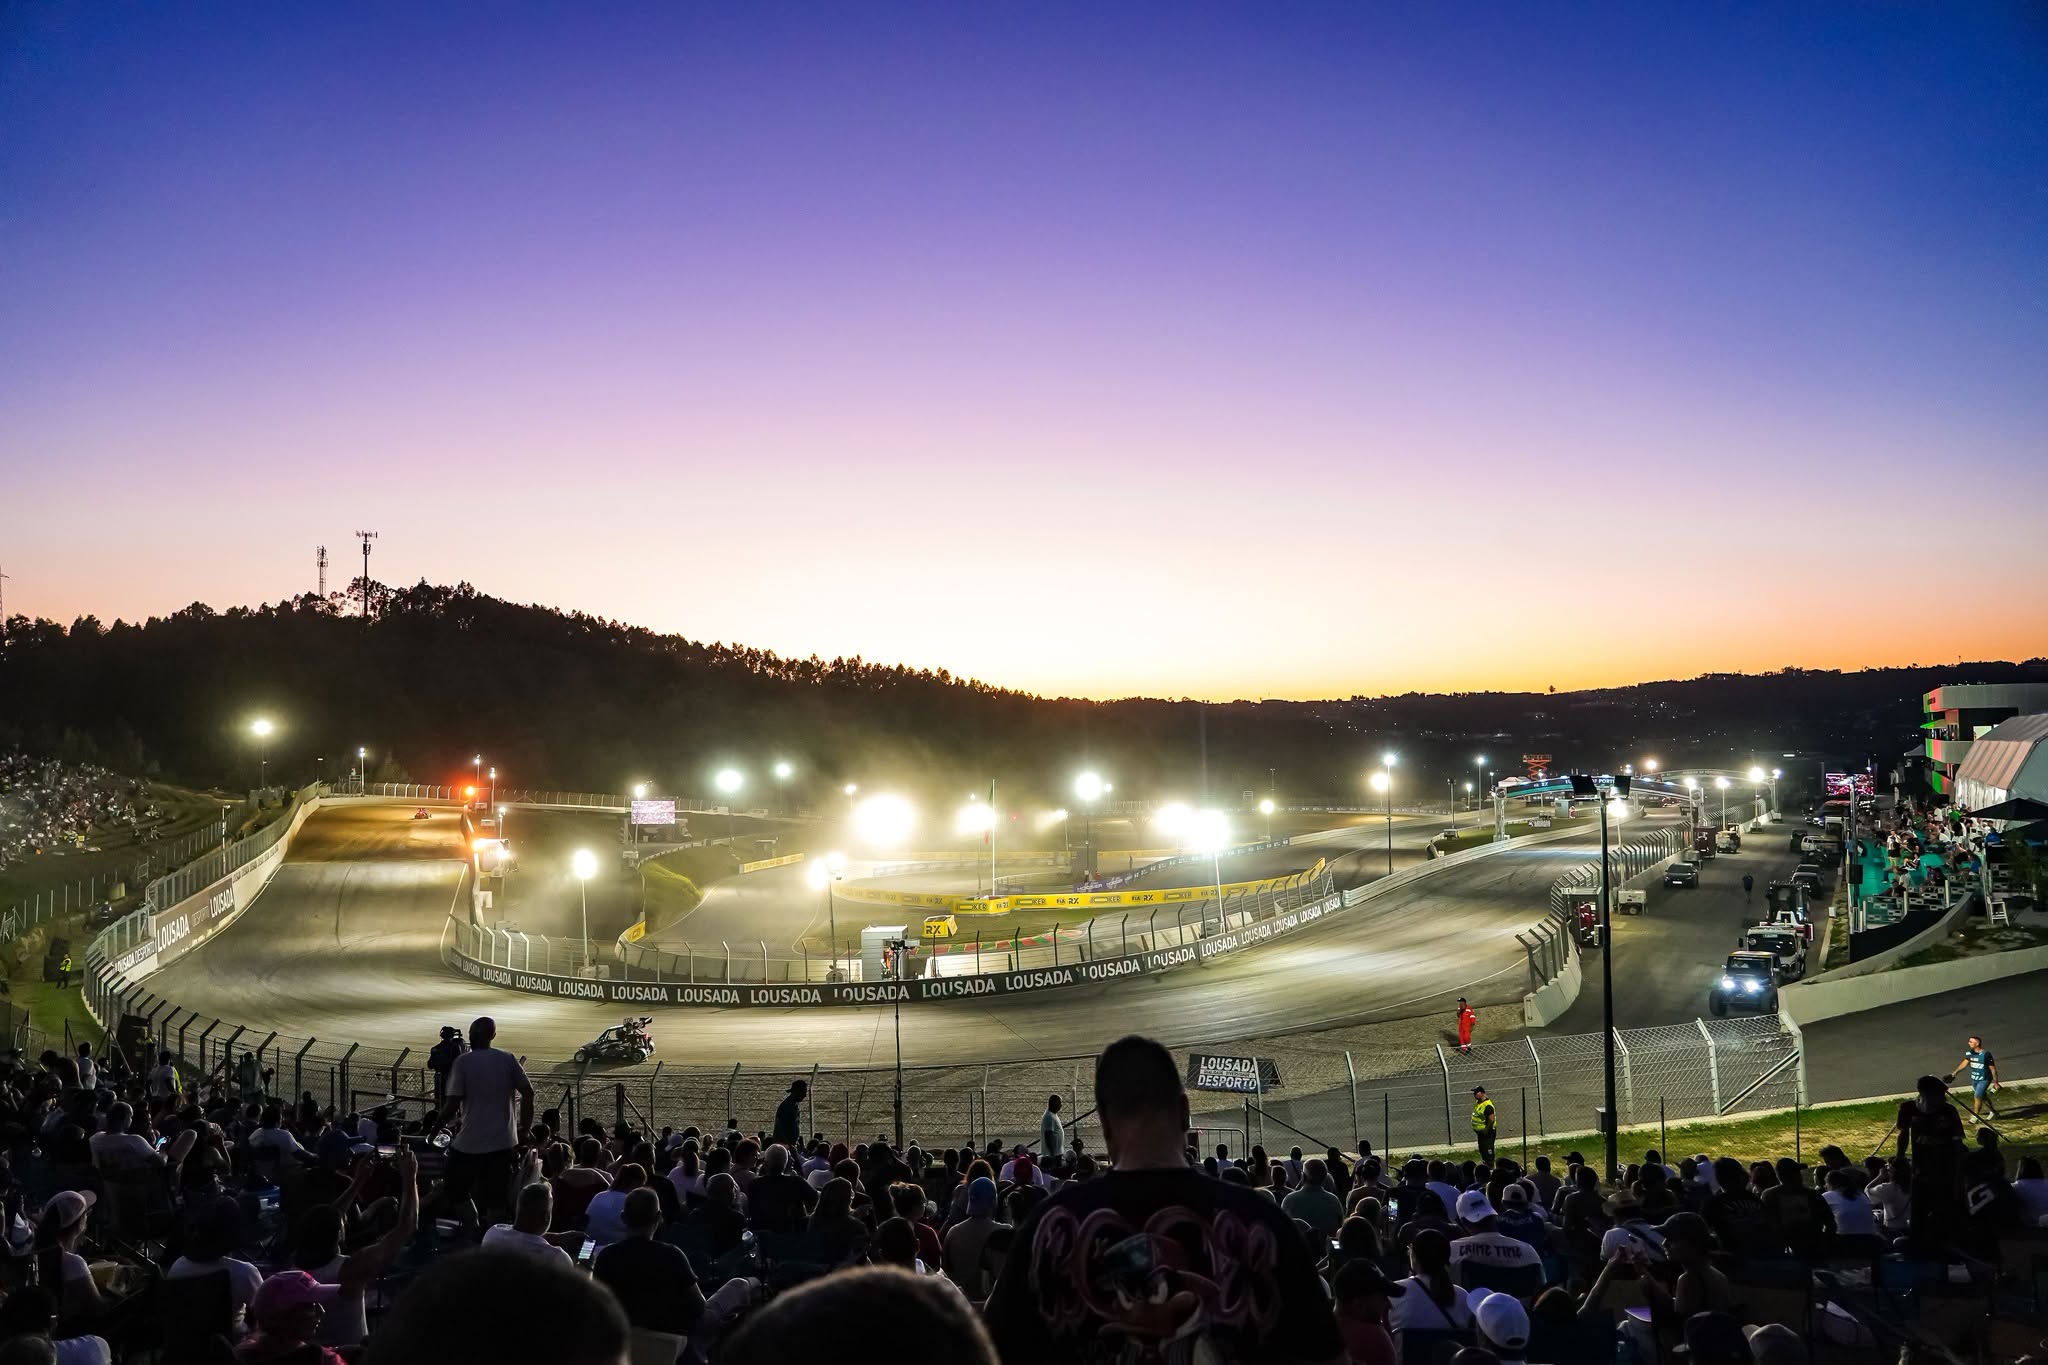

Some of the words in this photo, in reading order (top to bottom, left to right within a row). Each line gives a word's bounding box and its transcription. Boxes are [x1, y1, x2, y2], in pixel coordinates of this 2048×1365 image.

[157, 913, 190, 952] LOUSADA
[210, 887, 235, 918] LOUSADA
[926, 925, 941, 934] RX
[462, 960, 480, 977] LOUSADA
[483, 968, 512, 986] LOUSADA
[516, 975, 552, 993] LOUSADA
[558, 981, 604, 998] LOUSADA
[612, 986, 668, 1001] LOUSADA
[677, 988, 740, 1004] LOUSADA
[750, 989, 822, 1004] LOUSADA
[922, 978, 996, 998] LOUSADA
[1005, 970, 1073, 990] LOUSADA
[1201, 936, 1238, 957] LOUSADA
[1241, 925, 1272, 944] LOUSADA
[1274, 915, 1298, 933] LOUSADA
[1300, 906, 1322, 923] LOUSADA
[1323, 897, 1341, 914] LOUSADA
[1198, 1075, 1256, 1089] DESPORTO
[1459, 1244, 1491, 1256] CRIME
[1495, 1246, 1522, 1258] TIME
